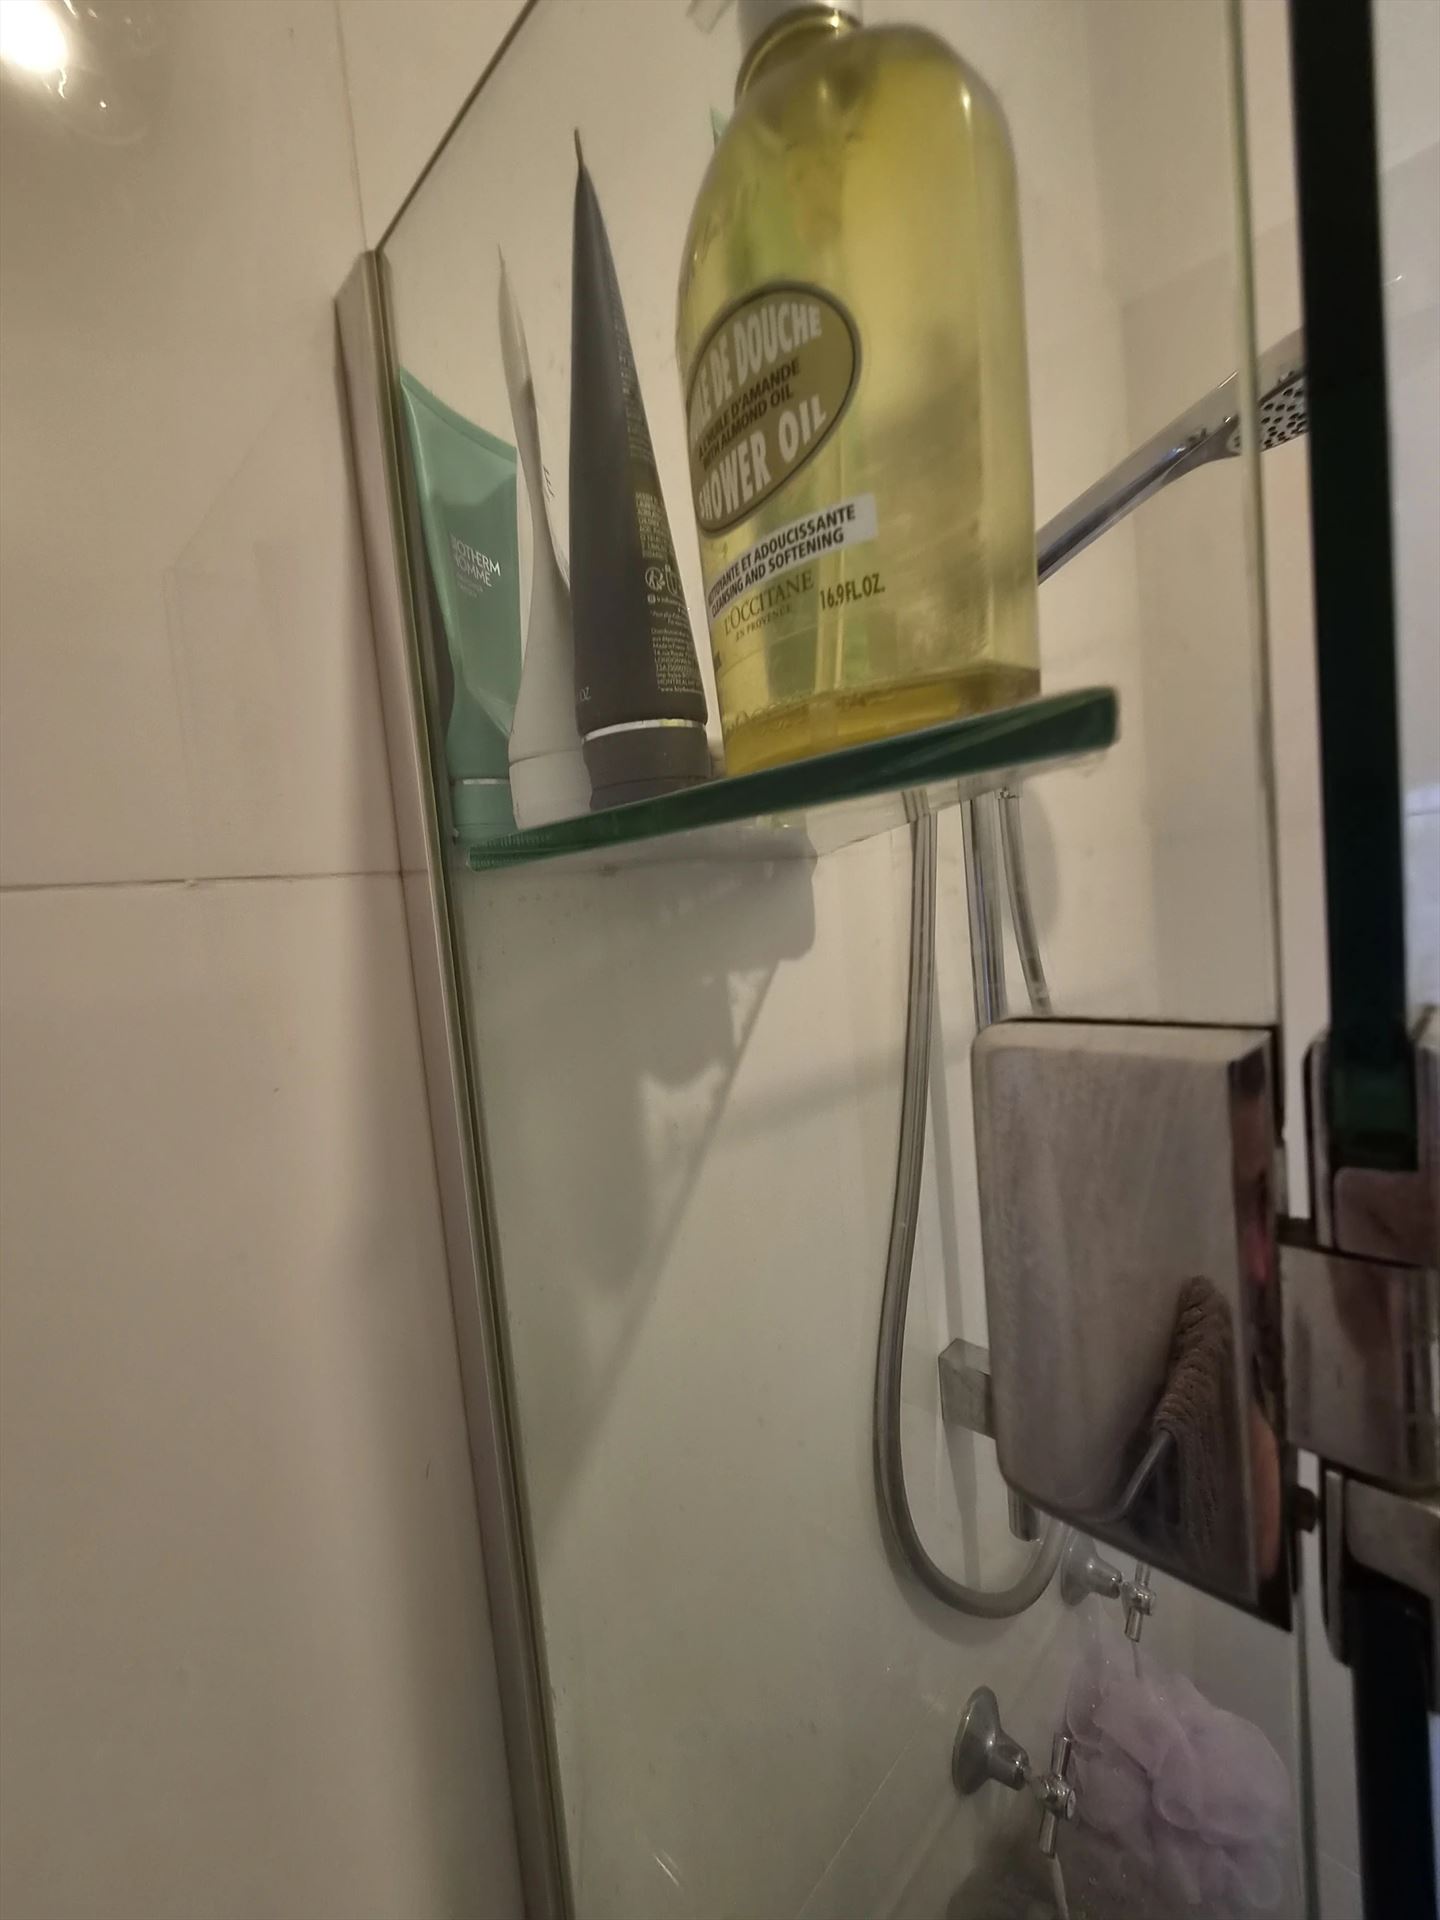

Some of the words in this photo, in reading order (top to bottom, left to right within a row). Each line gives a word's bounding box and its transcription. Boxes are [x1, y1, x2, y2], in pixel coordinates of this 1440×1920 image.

[709, 333, 733, 407] DE
[733, 302, 822, 386] DOUCHE
[731, 358, 800, 417] D'AMANDE
[720, 399, 768, 452] ALMOND
[769, 384, 794, 408] OIL
[699, 430, 772, 521] SHOWER
[777, 394, 827, 463] OIL
[740, 553, 753, 572] ET
[753, 504, 856, 564] ADOUCISSANTE
[744, 563, 767, 588] AND
[768, 527, 845, 573] SOFTENING
[724, 570, 815, 637] L'OCCITANE
